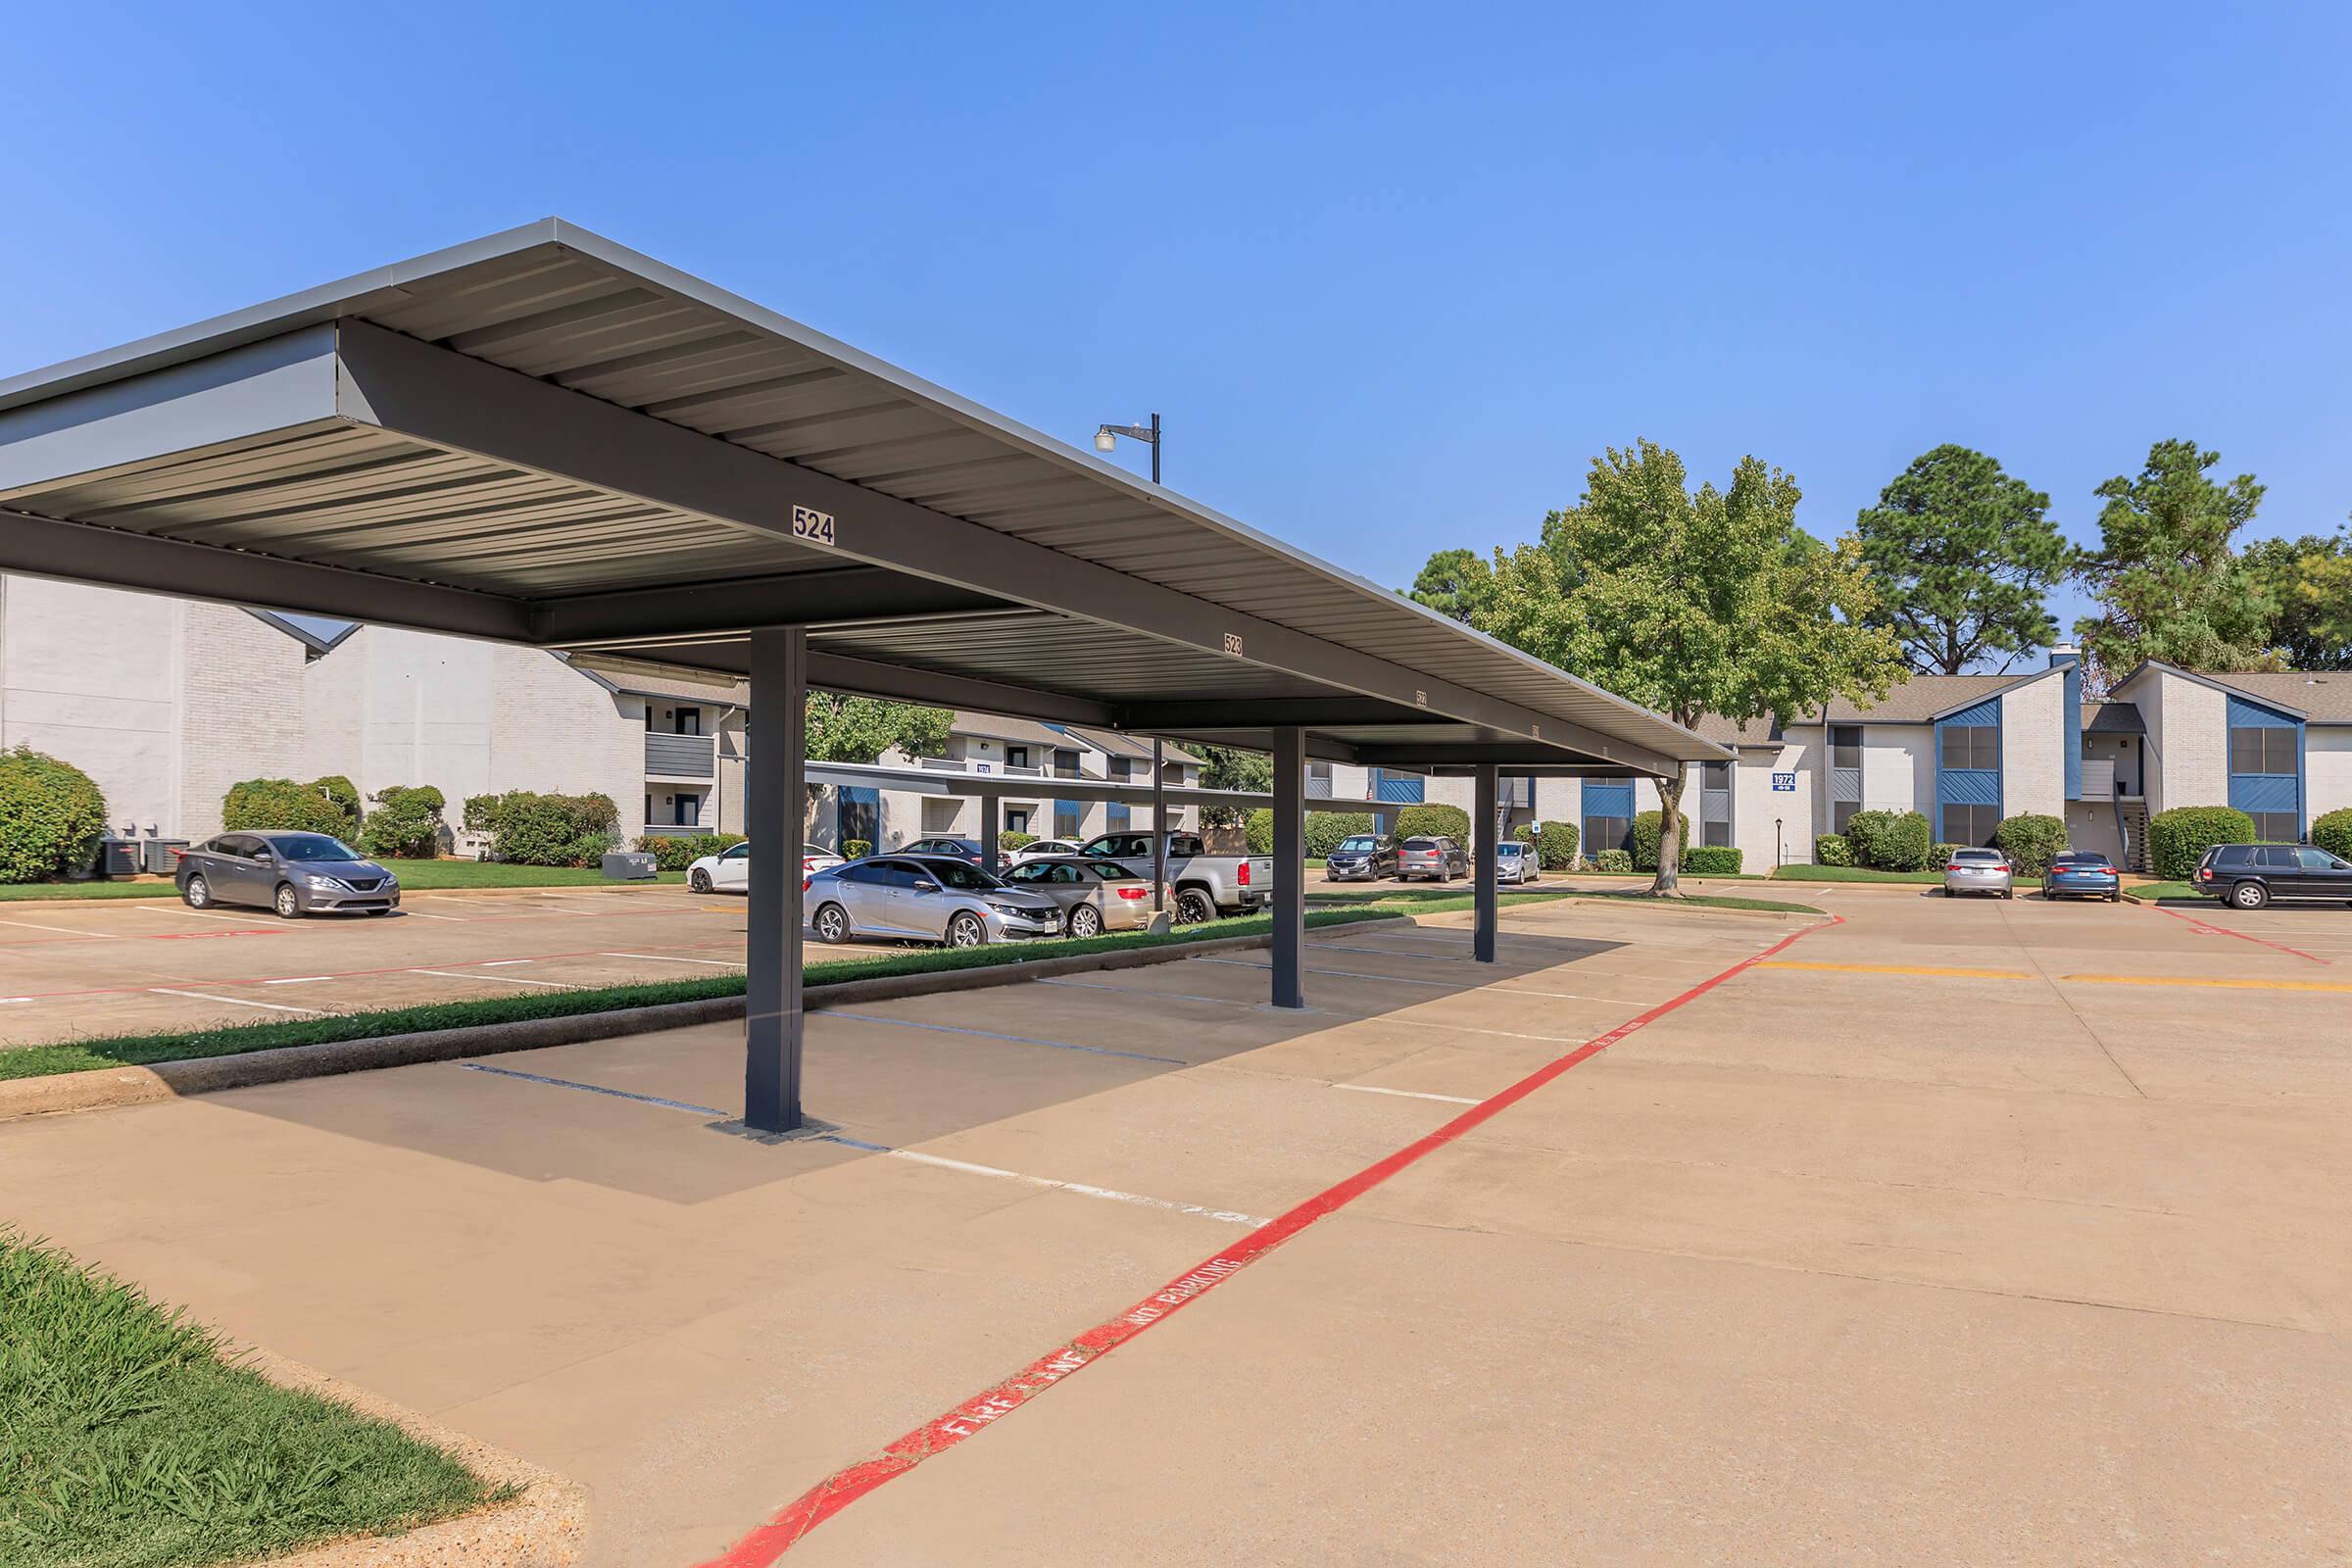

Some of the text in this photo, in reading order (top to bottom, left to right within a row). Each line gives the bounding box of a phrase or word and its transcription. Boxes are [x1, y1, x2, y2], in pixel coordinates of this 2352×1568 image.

[795, 508, 833, 543] 524
[1225, 634, 1242, 655] 523
[1774, 774, 1793, 784] 1972
[1123, 1306, 1162, 1326] NO
[1155, 1258, 1241, 1305] PARKING
